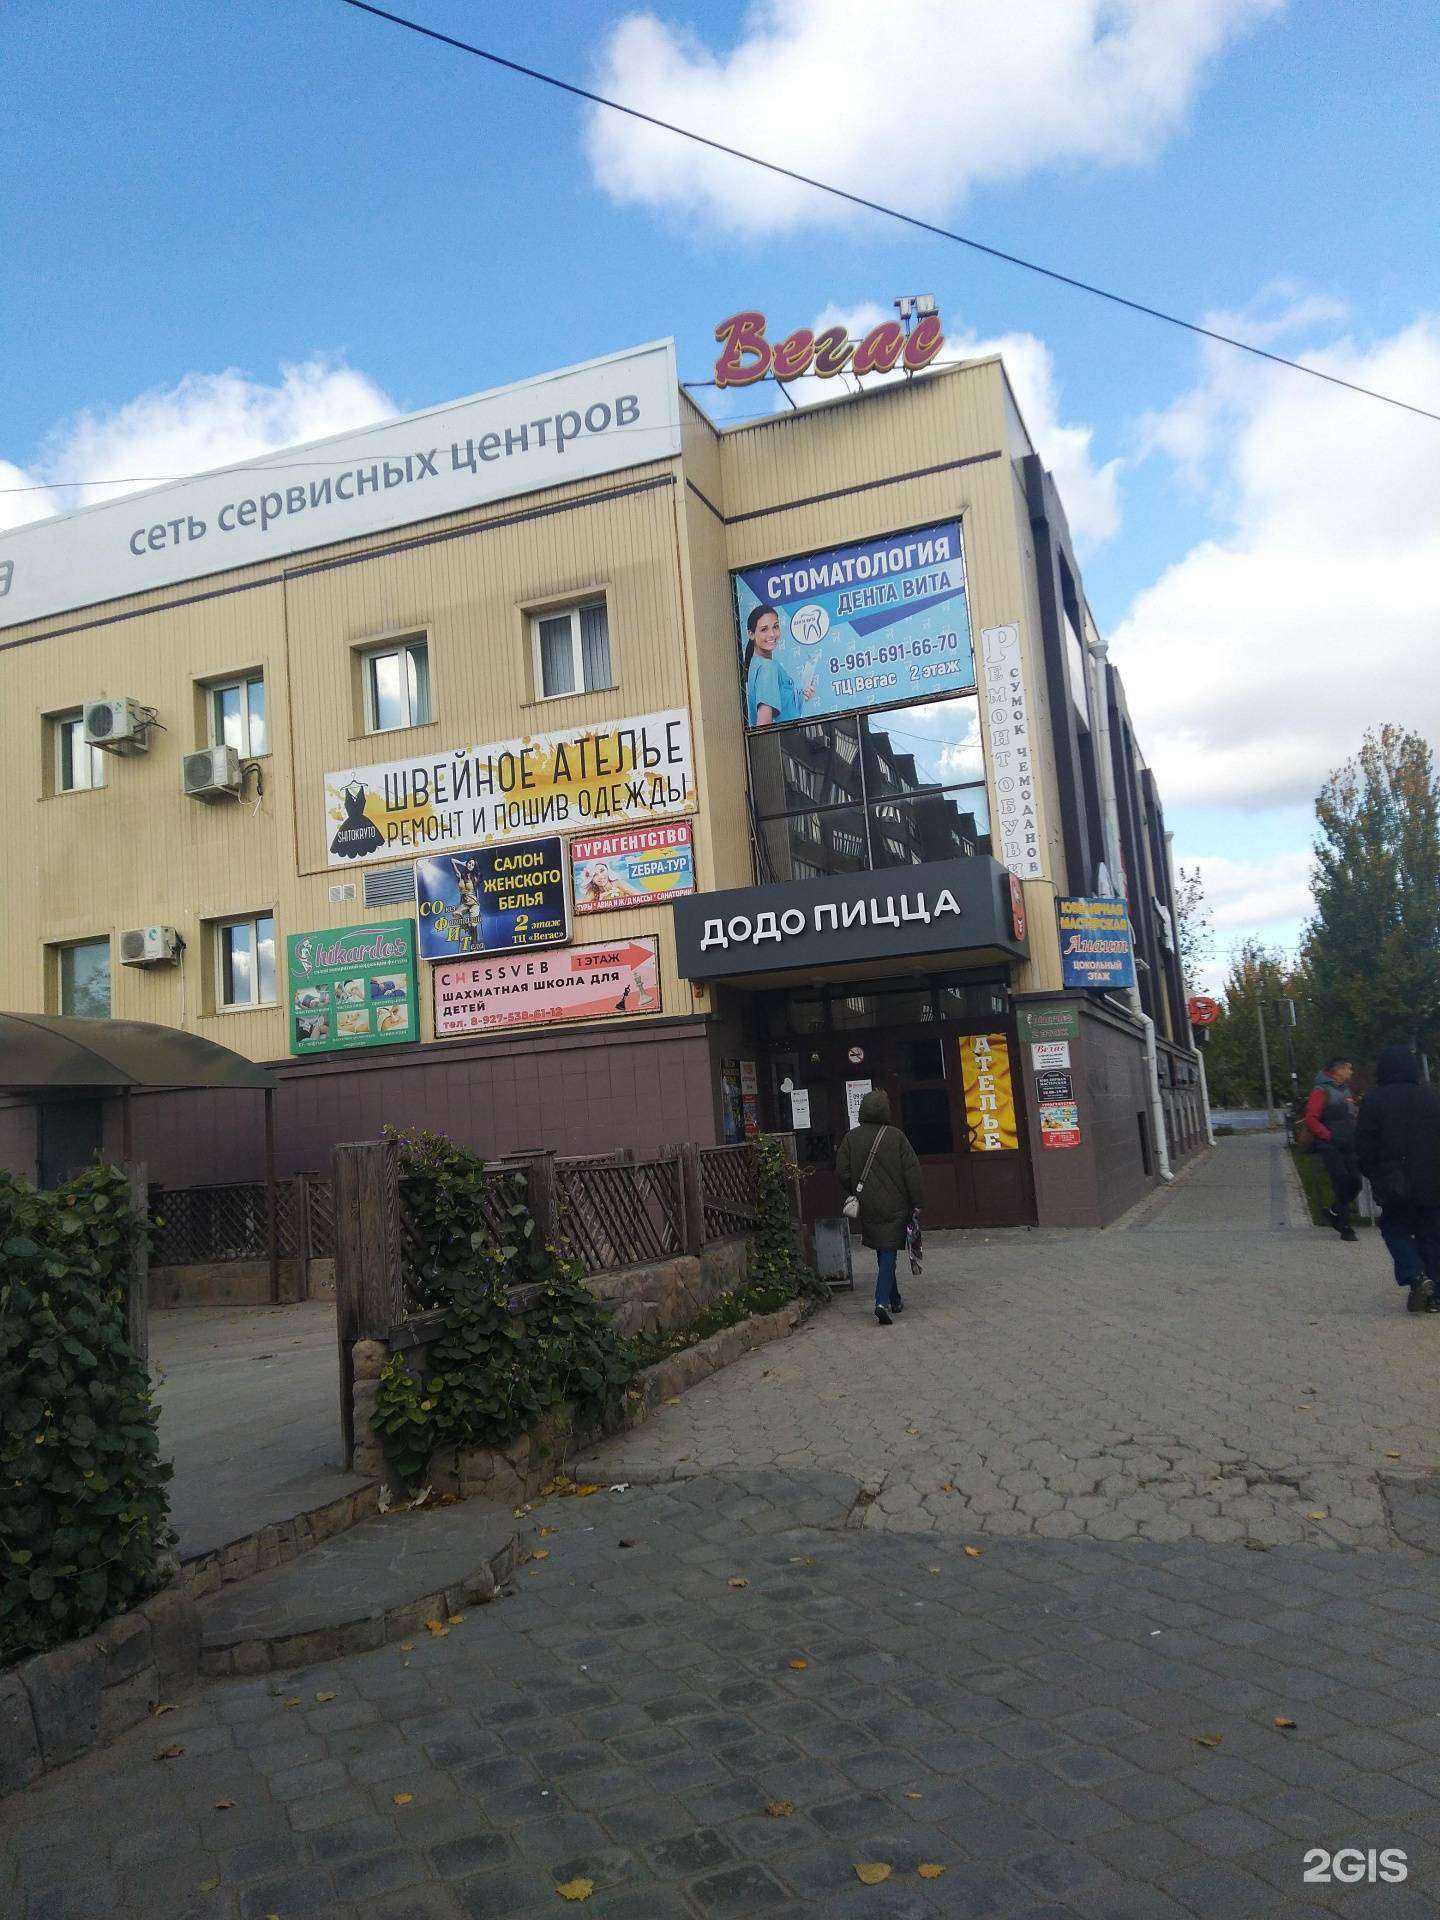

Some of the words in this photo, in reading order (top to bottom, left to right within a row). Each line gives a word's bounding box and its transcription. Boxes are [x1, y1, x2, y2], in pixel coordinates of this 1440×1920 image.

[715, 312, 945, 389] Вегас
[129, 512, 207, 557] сеть
[218, 451, 439, 532] сервисных
[451, 394, 641, 473] центров
[767, 536, 951, 600] СТОМАТОЛОГИЯ
[836, 586, 899, 617] ДЕНТА
[902, 570, 952, 600] ВИТА
[829, 633, 958, 674] 8-961-691-66-70
[832, 680, 853, 697] ТЦ
[855, 672, 897, 693] Вегас
[910, 664, 921, 682] 2
[921, 659, 962, 679] этаж
[983, 624, 1019, 768] РЕМОНТ
[1010, 667, 1025, 735] СУМОК
[384, 747, 536, 813] ШВЕЙНОЕ
[553, 720, 684, 784] АТЕЛЬЕ
[387, 812, 462, 849] РЕМОНТ
[472, 806, 486, 835] И
[493, 793, 569, 831] ПОШИВ
[578, 772, 688, 817] ОДЕЖДЫ
[1017, 747, 1039, 873] ЧЕМОДАНОВ
[575, 827, 687, 857] ТУРАГЕНТСТВО
[494, 852, 544, 872] САЛОН
[483, 870, 561, 893] ЖЕНСКОГО
[499, 892, 543, 910] БЕЛЬЯ
[633, 894, 652, 904] КАССЫ
[515, 914, 528, 931] 2
[531, 919, 561, 930] этаж
[701, 908, 805, 951] ДОДО
[814, 889, 961, 932] ПИЦЦА
[1060, 917, 1128, 931] МАСТЕРСКАЯ
[512, 935, 527, 944] ТЦ
[441, 961, 549, 986] CHESSVEB
[577, 957, 582, 967] 1
[584, 953, 621, 966] ЭТАЖ
[1073, 960, 1122, 970] ЦОКОЛЬНЫЙ
[443, 983, 528, 1001] ШАХМАТНАЯ
[534, 977, 585, 990] ШКОЛА
[590, 971, 620, 985] ДЛЯ
[1087, 972, 1110, 981] ЭТАЖ
[443, 1001, 485, 1017] ДЕТЕЙ
[443, 1020, 467, 1030] тел.
[974, 1037, 1001, 1151] АТЕЛЬЕ
